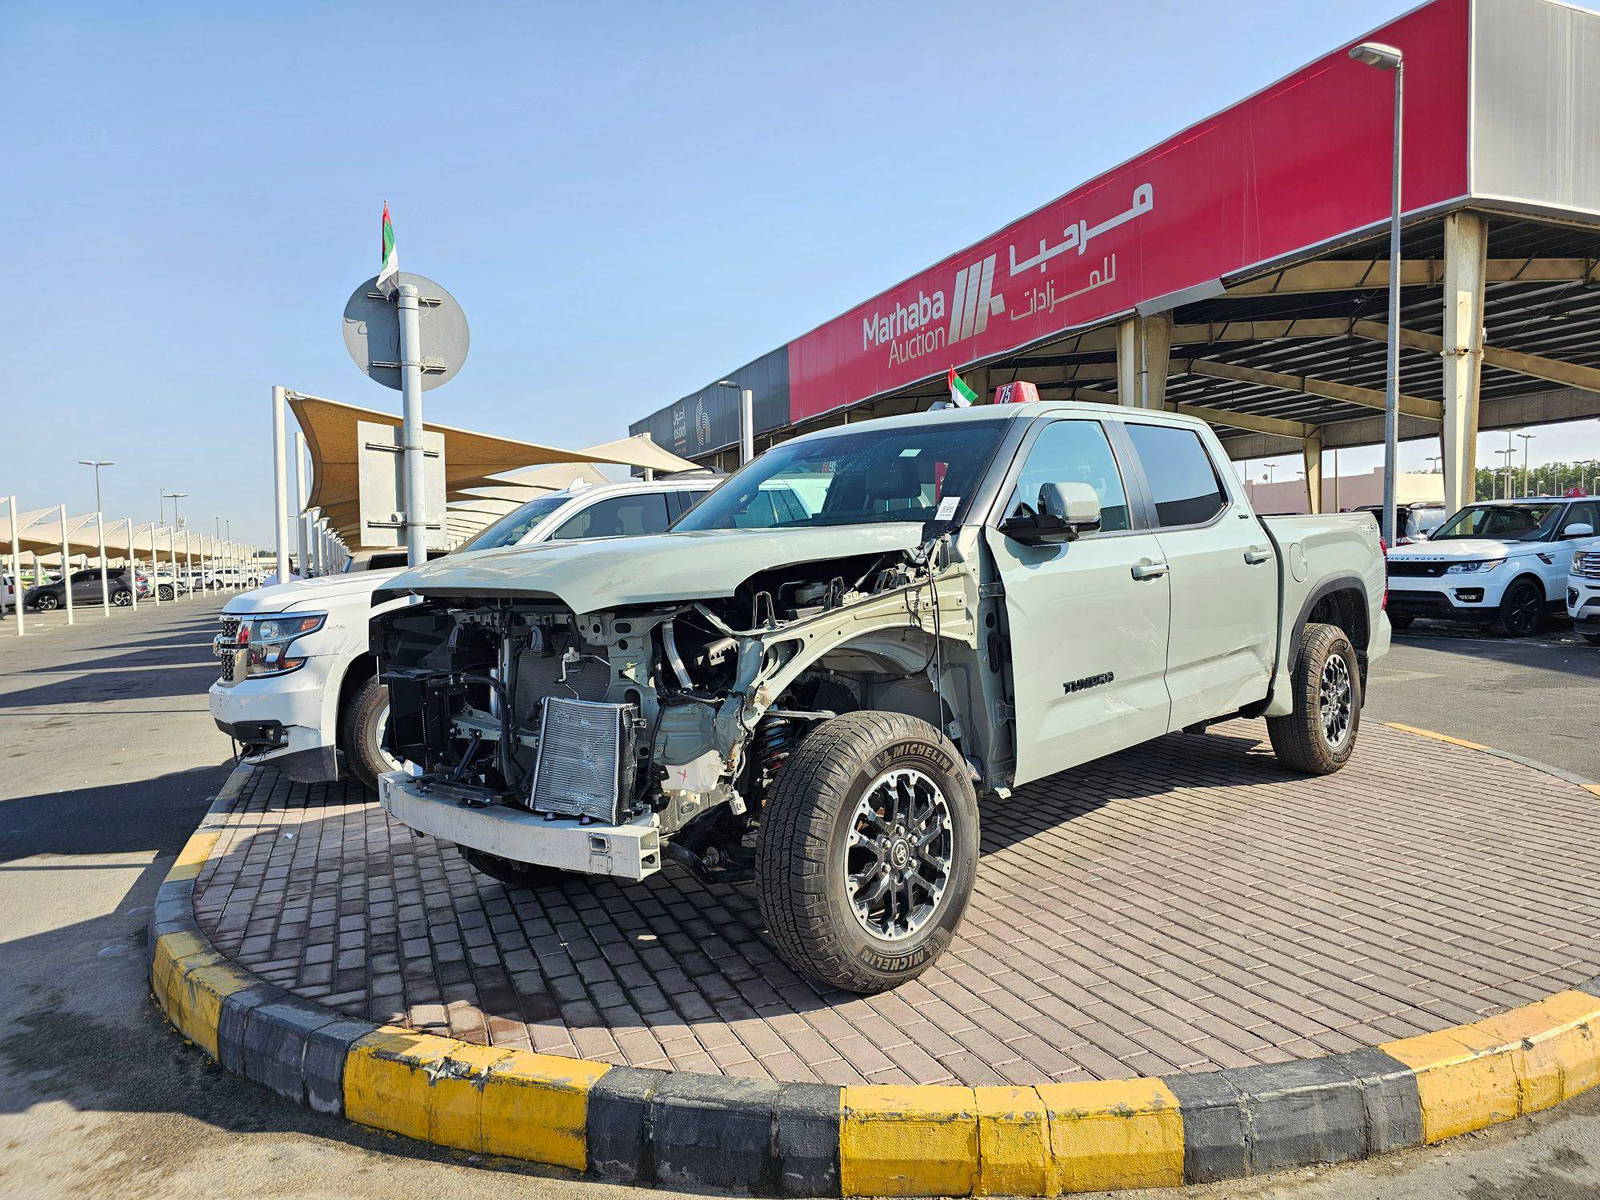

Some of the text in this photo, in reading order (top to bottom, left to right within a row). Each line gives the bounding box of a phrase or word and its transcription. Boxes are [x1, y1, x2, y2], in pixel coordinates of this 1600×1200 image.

[1009, 182, 1153, 277] مرحبا
[863, 290, 945, 351] Marhaba
[888, 326, 945, 368] Auction
[893, 743, 952, 770] MICHELIN
[860, 949, 925, 971] MICHELIN
